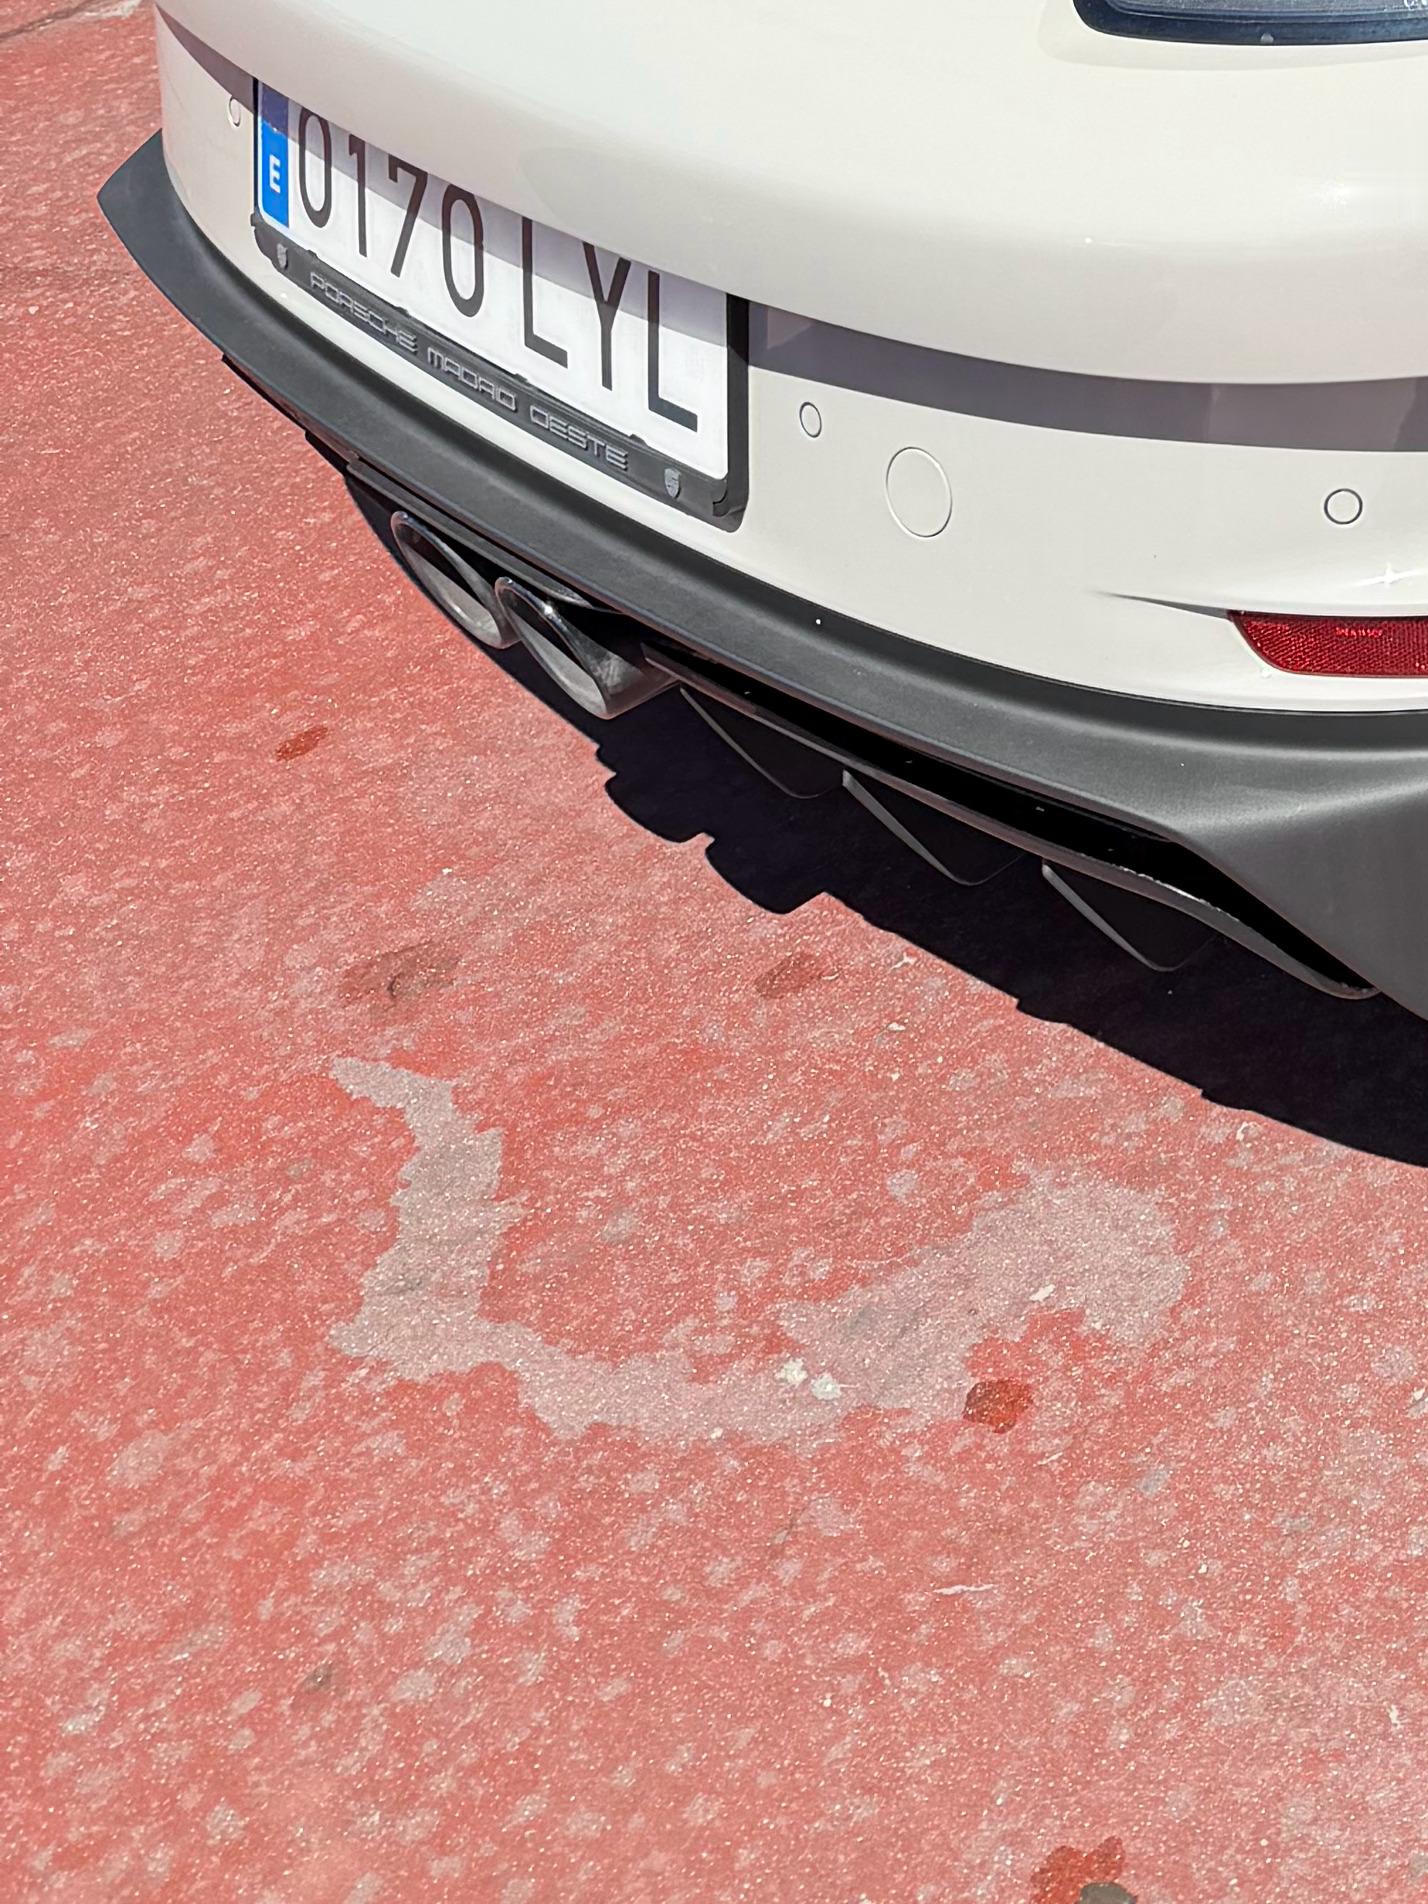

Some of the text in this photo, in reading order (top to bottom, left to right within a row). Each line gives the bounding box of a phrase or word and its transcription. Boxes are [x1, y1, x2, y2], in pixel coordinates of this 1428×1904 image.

[268, 154, 282, 195] E
[299, 106, 485, 318] 0170
[311, 272, 418, 354] PORSCHE
[530, 404, 628, 471] OESTE
[521, 215, 698, 434] LYL
